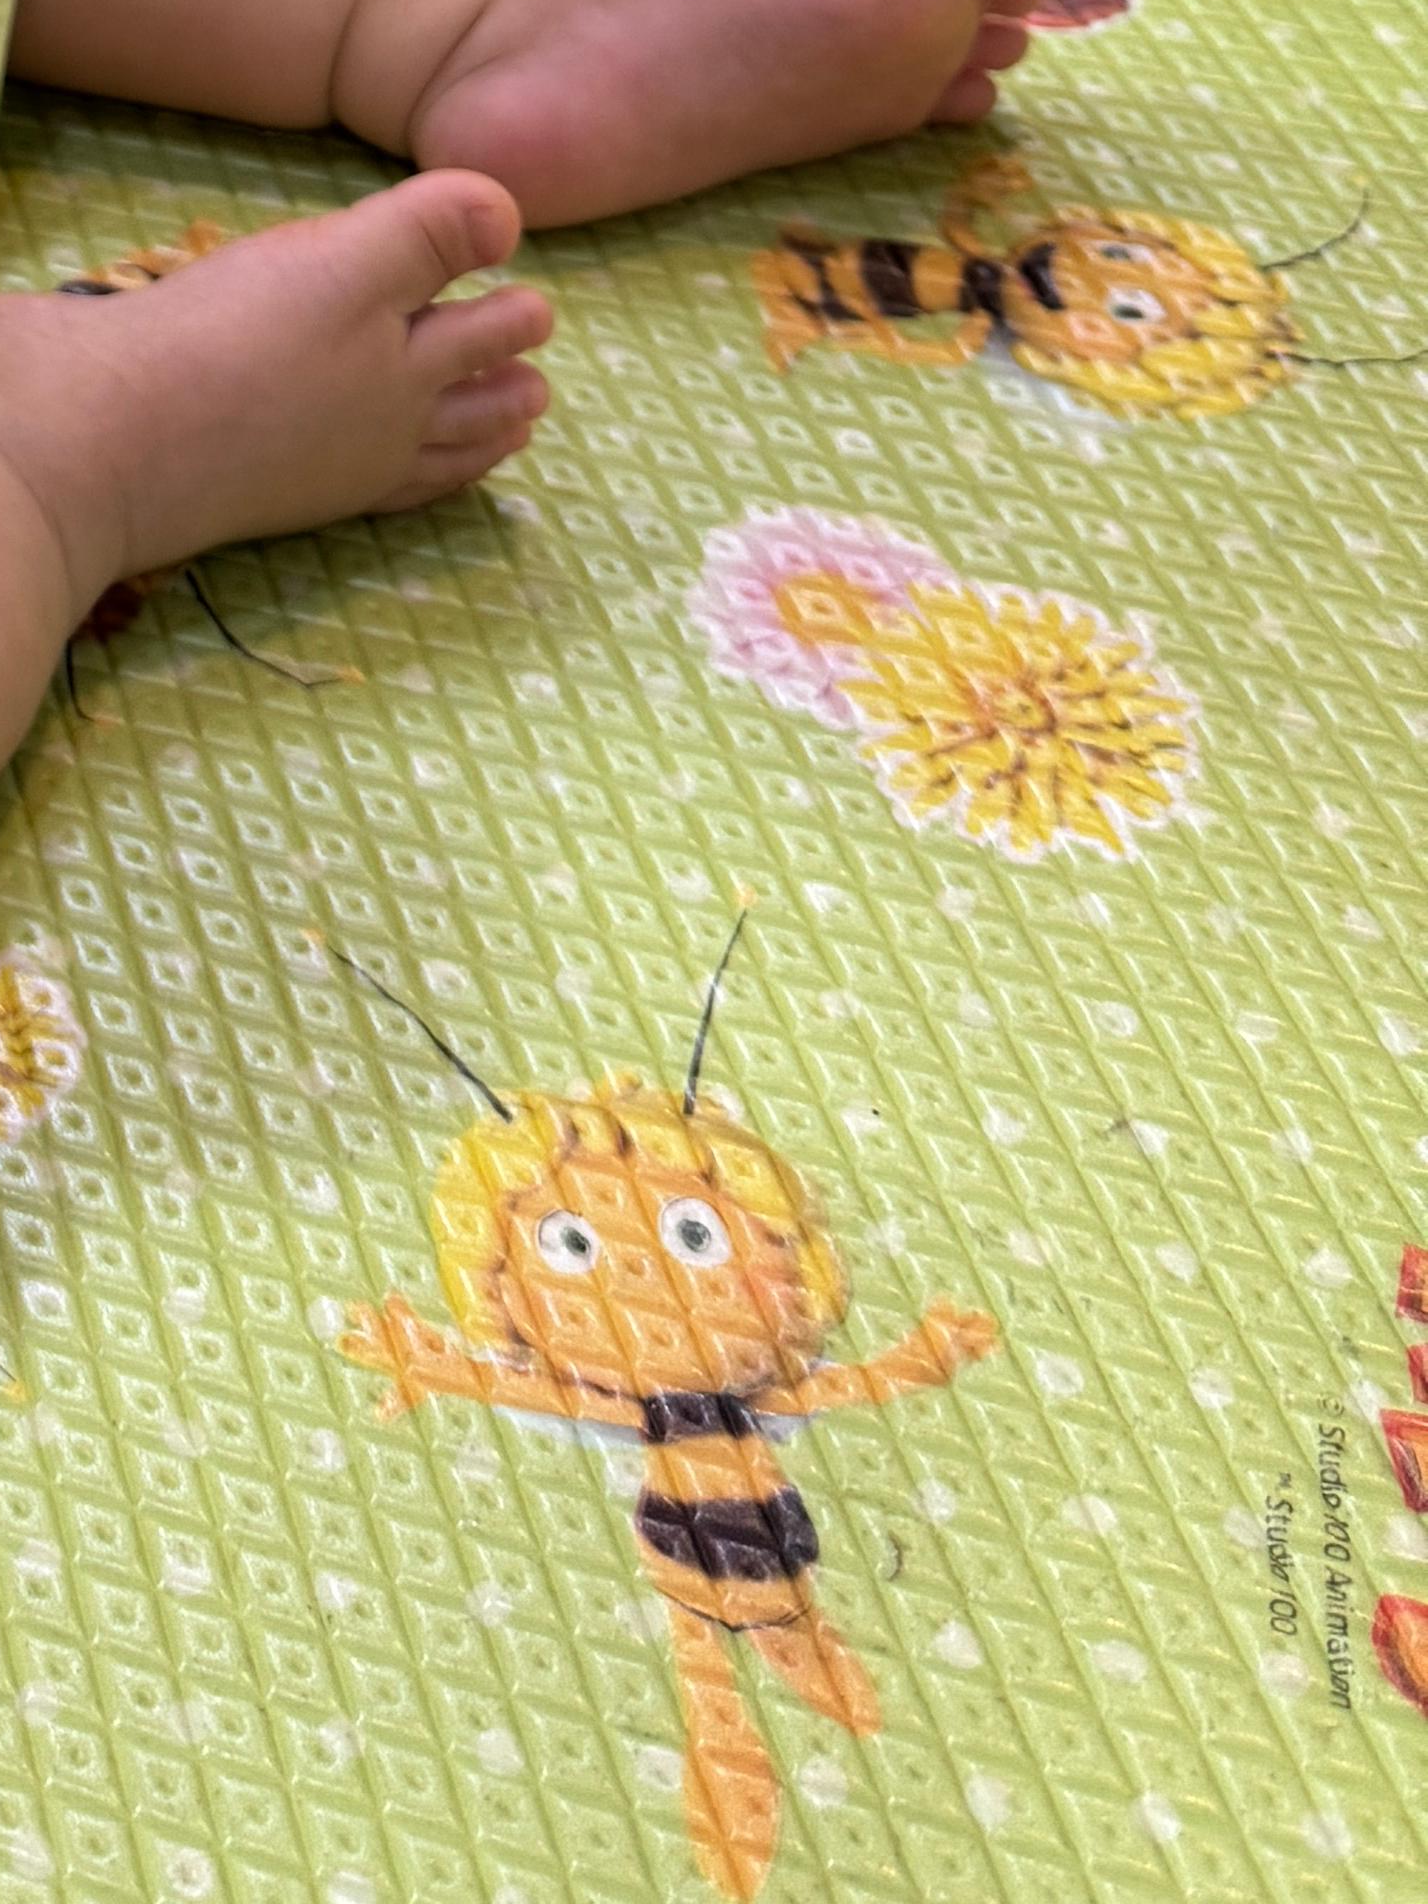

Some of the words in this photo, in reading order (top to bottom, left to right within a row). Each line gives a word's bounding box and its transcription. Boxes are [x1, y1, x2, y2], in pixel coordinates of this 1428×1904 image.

[1318, 1423, 1347, 1510] Studio
[1266, 1495, 1295, 1583] Studio
[1323, 1512, 1352, 1563] 100
[1269, 1587, 1299, 1637] 100
[1324, 1566, 1355, 1712] Animation
